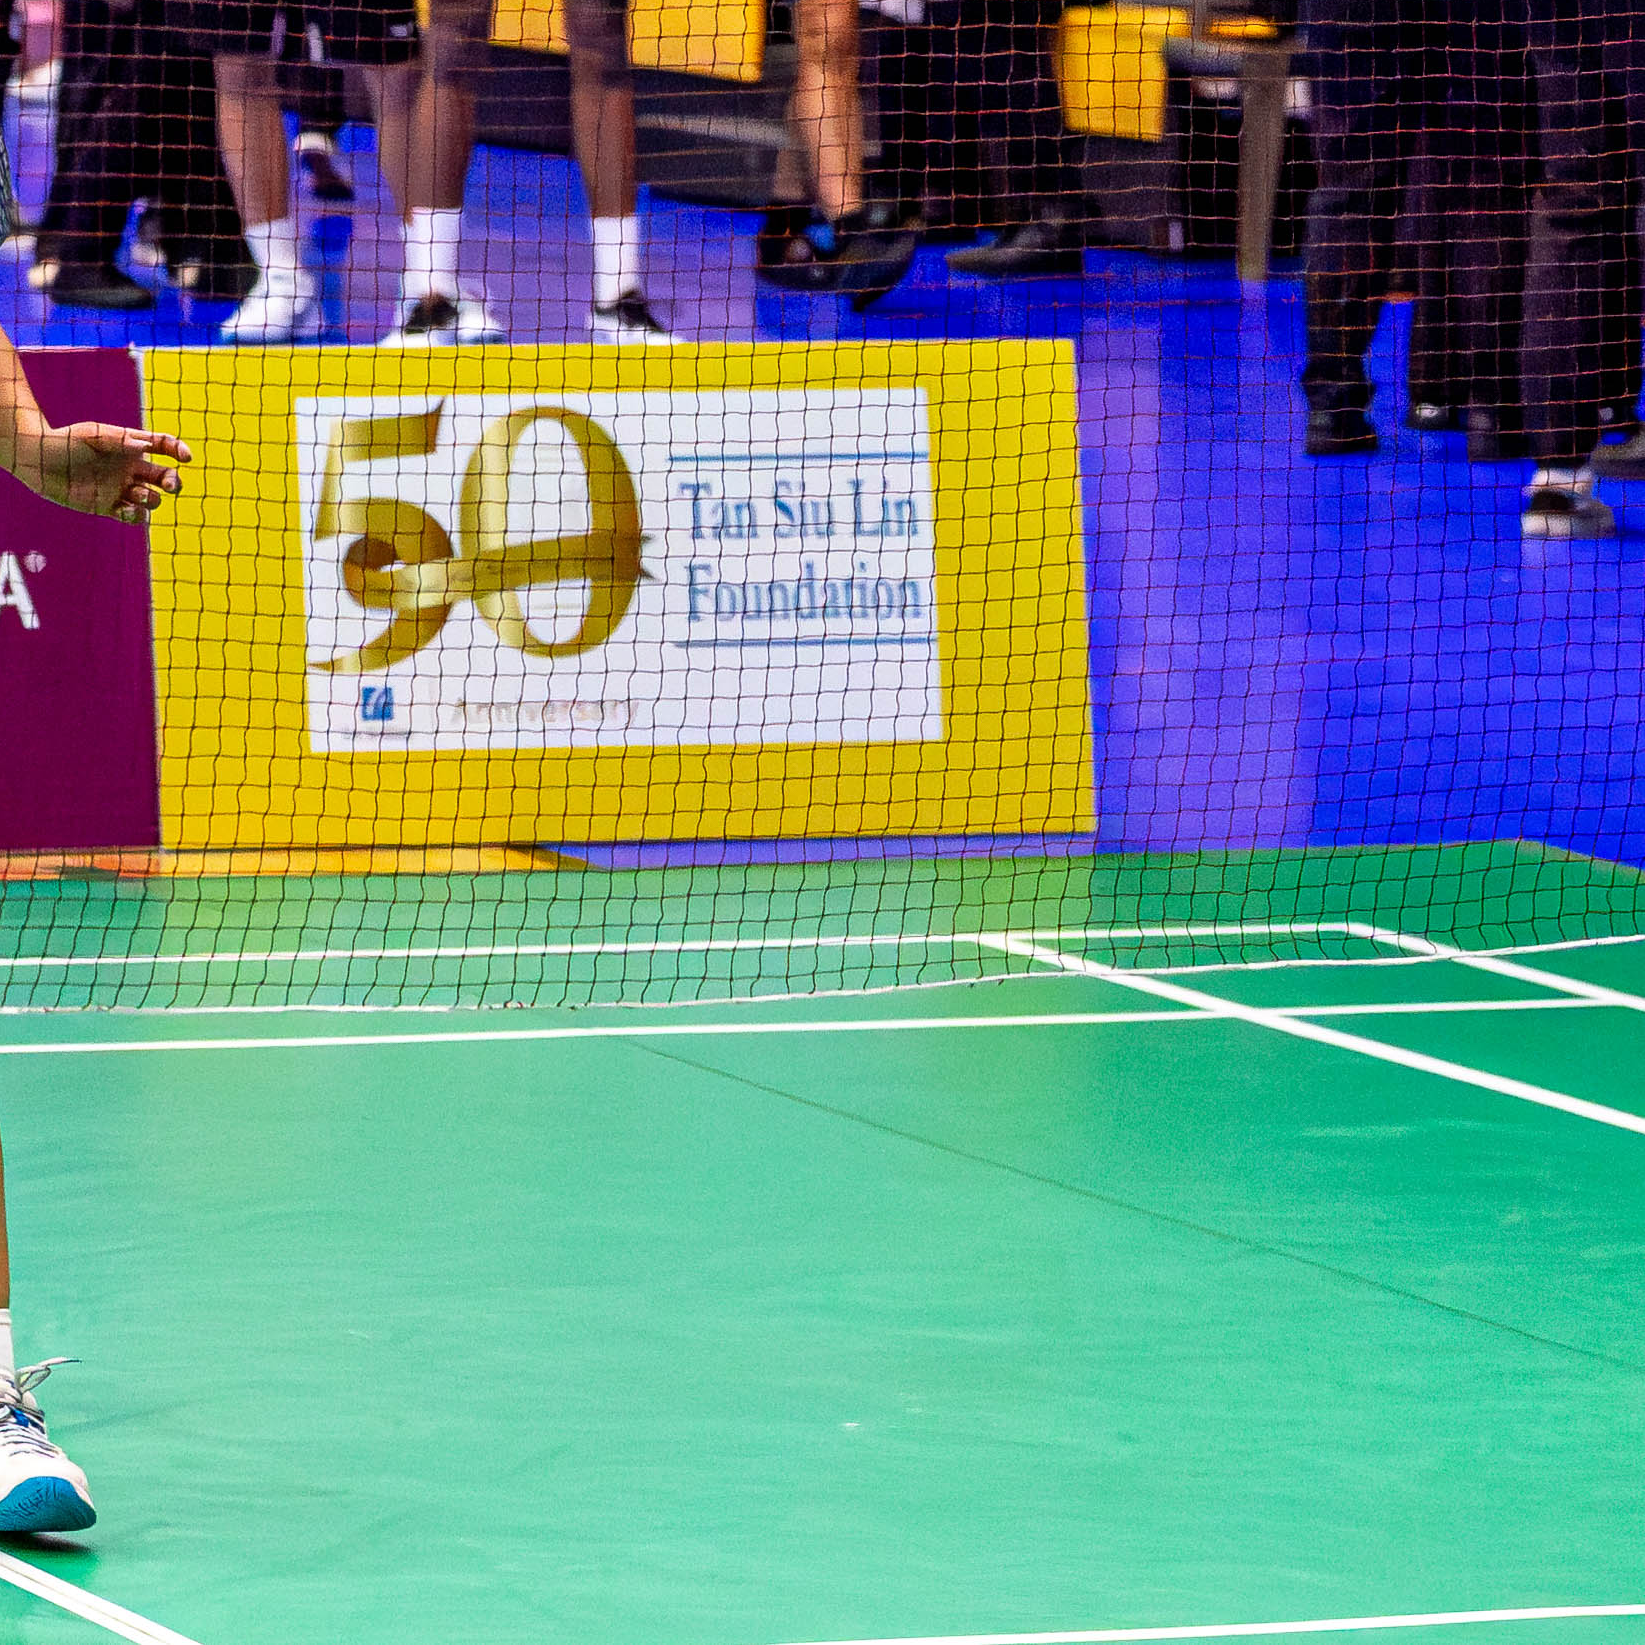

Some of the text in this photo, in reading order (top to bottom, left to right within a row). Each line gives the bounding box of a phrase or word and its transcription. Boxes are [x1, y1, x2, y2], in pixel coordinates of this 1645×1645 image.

[310, 397, 654, 675] 50
[677, 477, 921, 541] Tan Siu Lin
[684, 559, 925, 623] Foundation
